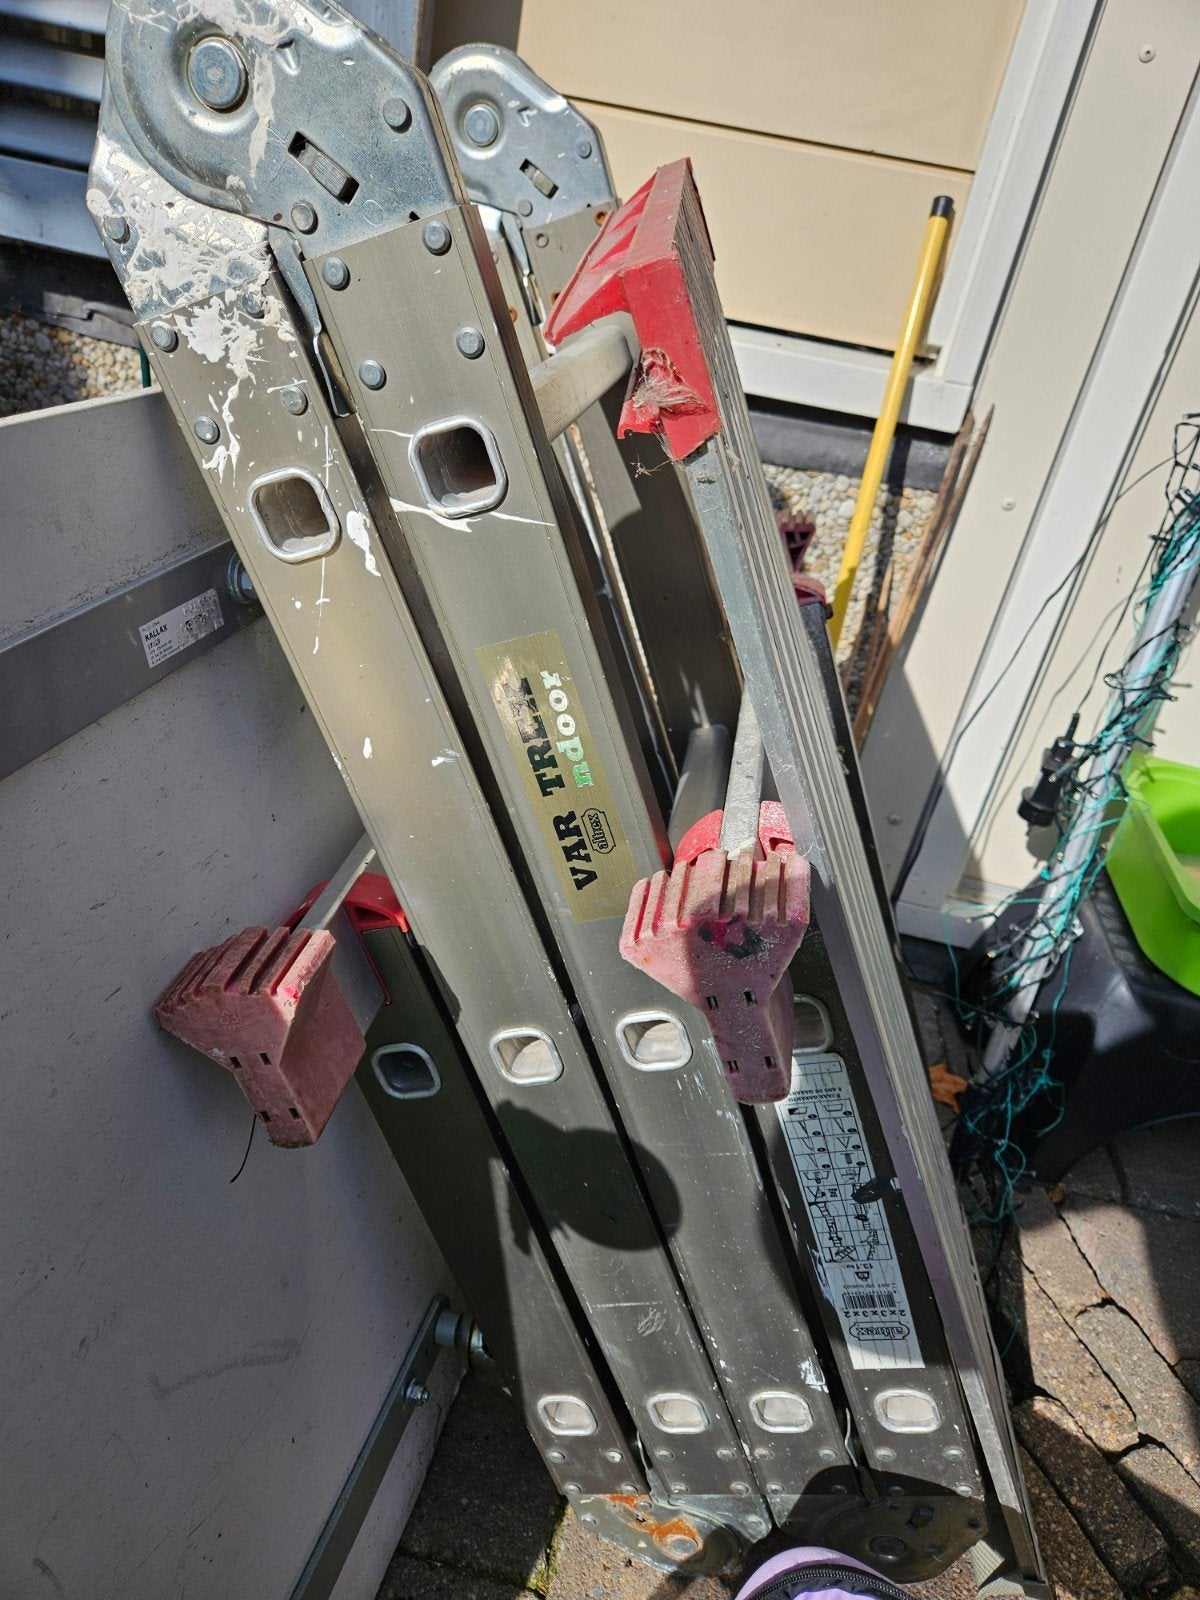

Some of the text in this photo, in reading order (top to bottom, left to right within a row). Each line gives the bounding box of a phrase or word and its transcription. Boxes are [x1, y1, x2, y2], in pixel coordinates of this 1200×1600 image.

[145, 624, 168, 641] KALLAX
[502, 677, 598, 891] VAR TREK
[588, 813, 609, 850] altrex
[898, 1309, 906, 1317] 2
[855, 1326, 903, 1338] altrex
